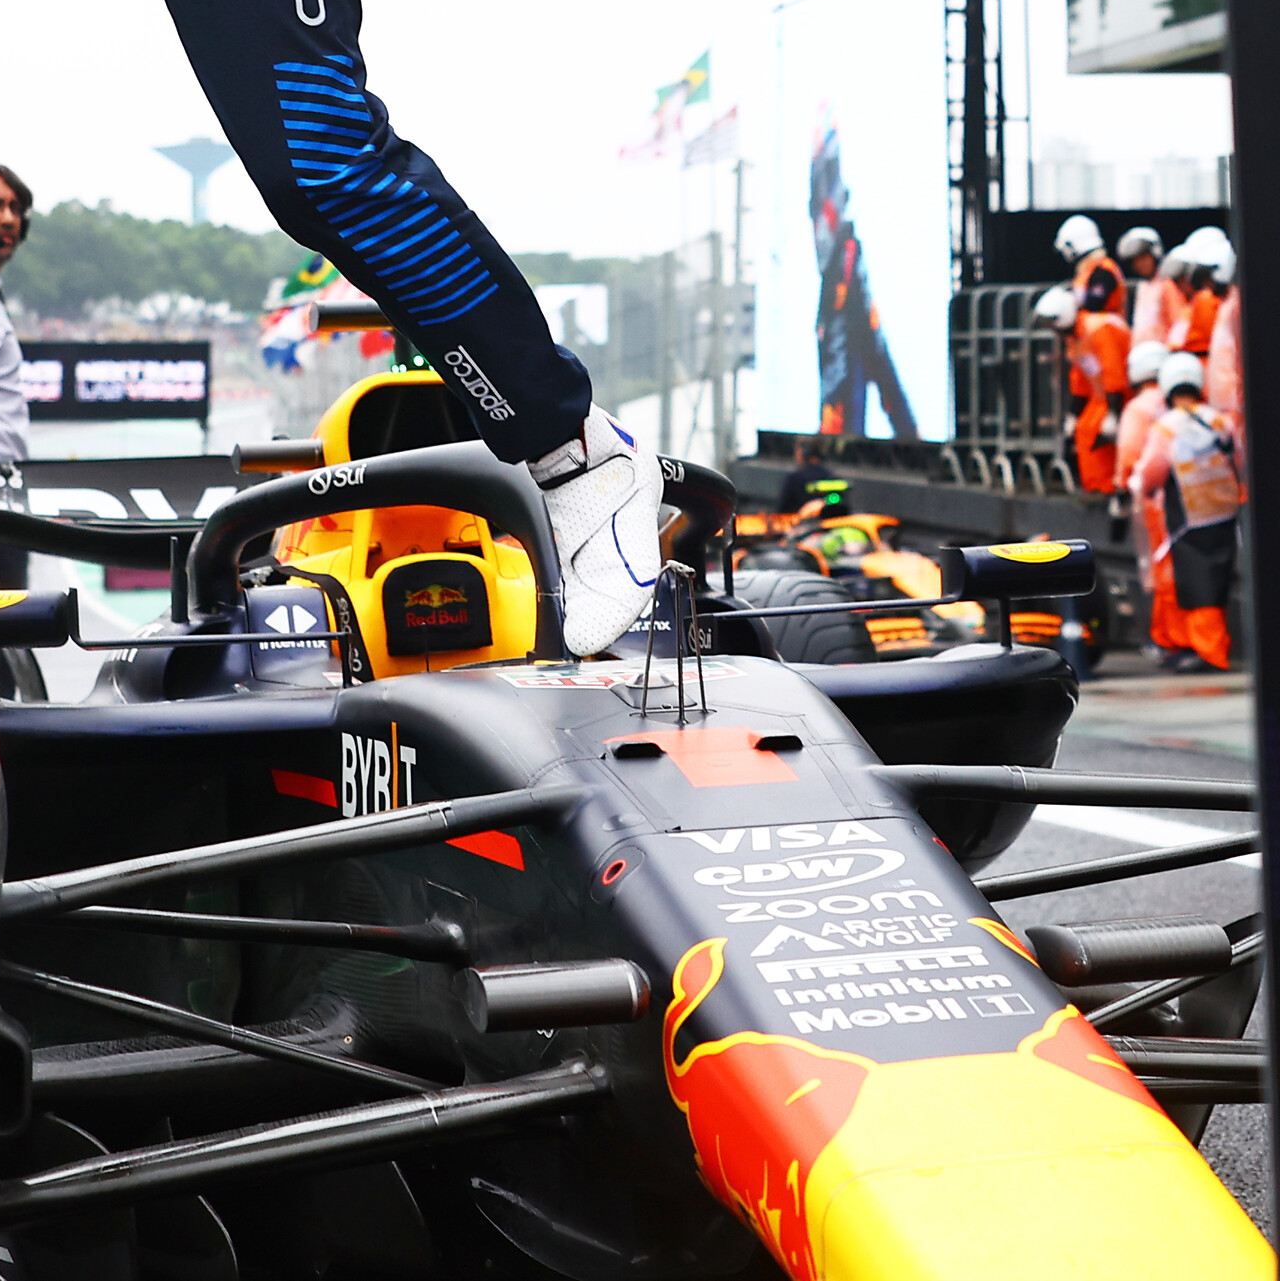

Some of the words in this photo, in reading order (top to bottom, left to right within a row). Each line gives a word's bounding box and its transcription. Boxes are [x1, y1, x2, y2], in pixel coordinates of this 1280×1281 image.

[444, 345, 516, 422] sparco
[333, 463, 368, 488] Sui
[405, 610, 437, 628] Red
[438, 608, 469, 626] Bull
[341, 721, 416, 818] BYBIT
[668, 821, 887, 855] VISA
[693, 856, 855, 887] CDW
[821, 913, 959, 937] ARCTIC
[843, 927, 955, 948] WOLF
[756, 946, 990, 983] PIRELLI
[774, 973, 1012, 1006] infinitum
[789, 997, 968, 1034] Mobil
